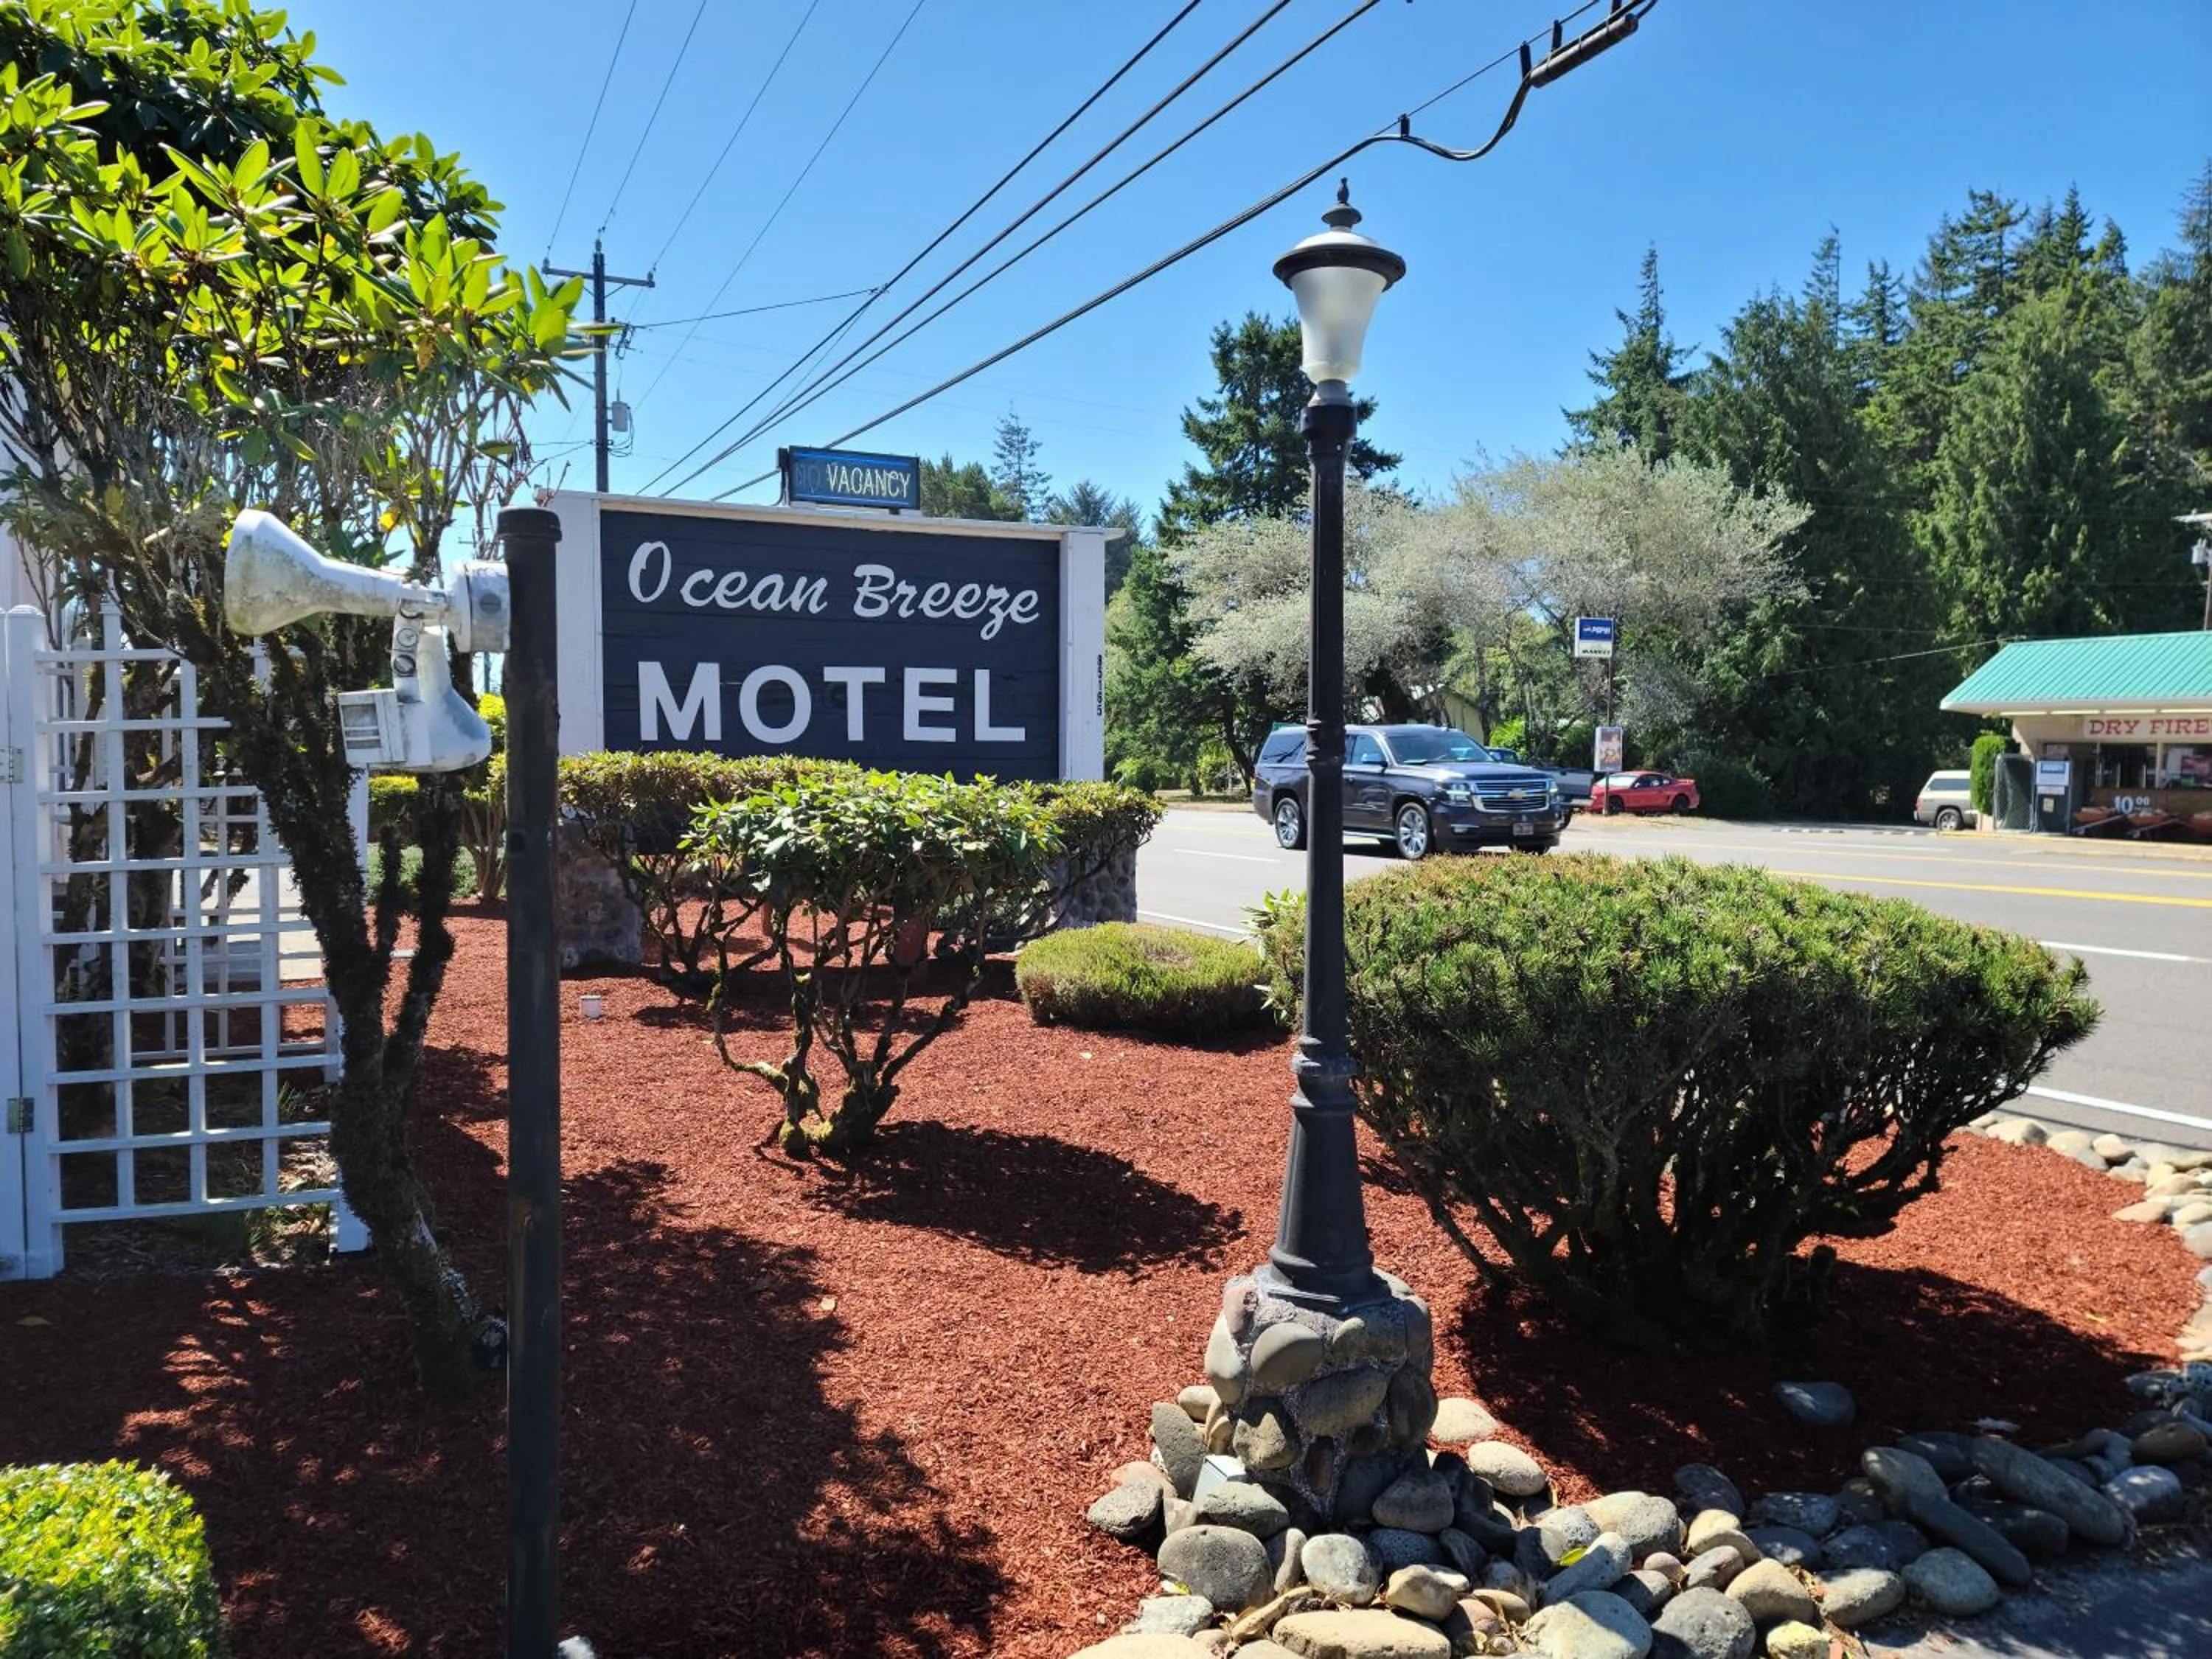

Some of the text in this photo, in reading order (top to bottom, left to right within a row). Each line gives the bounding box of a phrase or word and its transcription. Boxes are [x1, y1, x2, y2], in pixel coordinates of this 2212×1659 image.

[826, 462, 911, 498] VACANCY
[628, 540, 1040, 641] Ocean Breeze
[638, 661, 1026, 744] MOTEL
[2089, 718, 2212, 735] DRY FIRE
